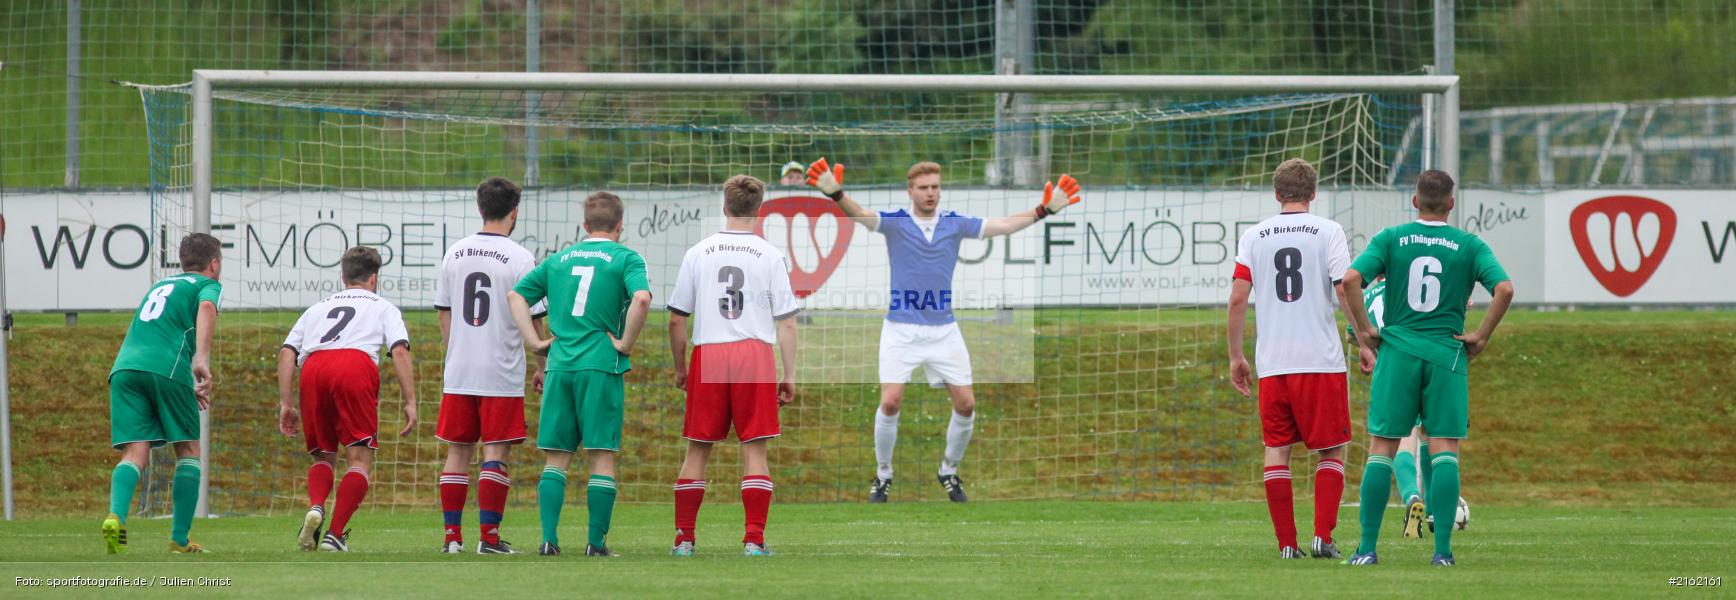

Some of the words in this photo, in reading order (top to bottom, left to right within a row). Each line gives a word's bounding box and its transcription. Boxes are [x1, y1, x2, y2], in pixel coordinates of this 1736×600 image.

[1259, 228, 1271, 239] SV
[1273, 224, 1319, 236] Birkenfeld
[1465, 202, 1532, 235] deine
[454, 249, 465, 260] SV
[467, 248, 510, 265] Birkenfeld
[570, 250, 612, 264] Thüngersheim
[705, 245, 716, 255] SV
[718, 244, 763, 259] Birkenfeld
[1399, 235, 1409, 247] FV
[1410, 234, 1460, 251] Thüngersheim
[571, 266, 595, 317] 7
[717, 265, 745, 320] 3
[1274, 247, 1303, 303] 8
[1407, 256, 1443, 313] 6
[139, 283, 175, 323] 8
[463, 272, 491, 327] 6
[320, 305, 357, 344] 2
